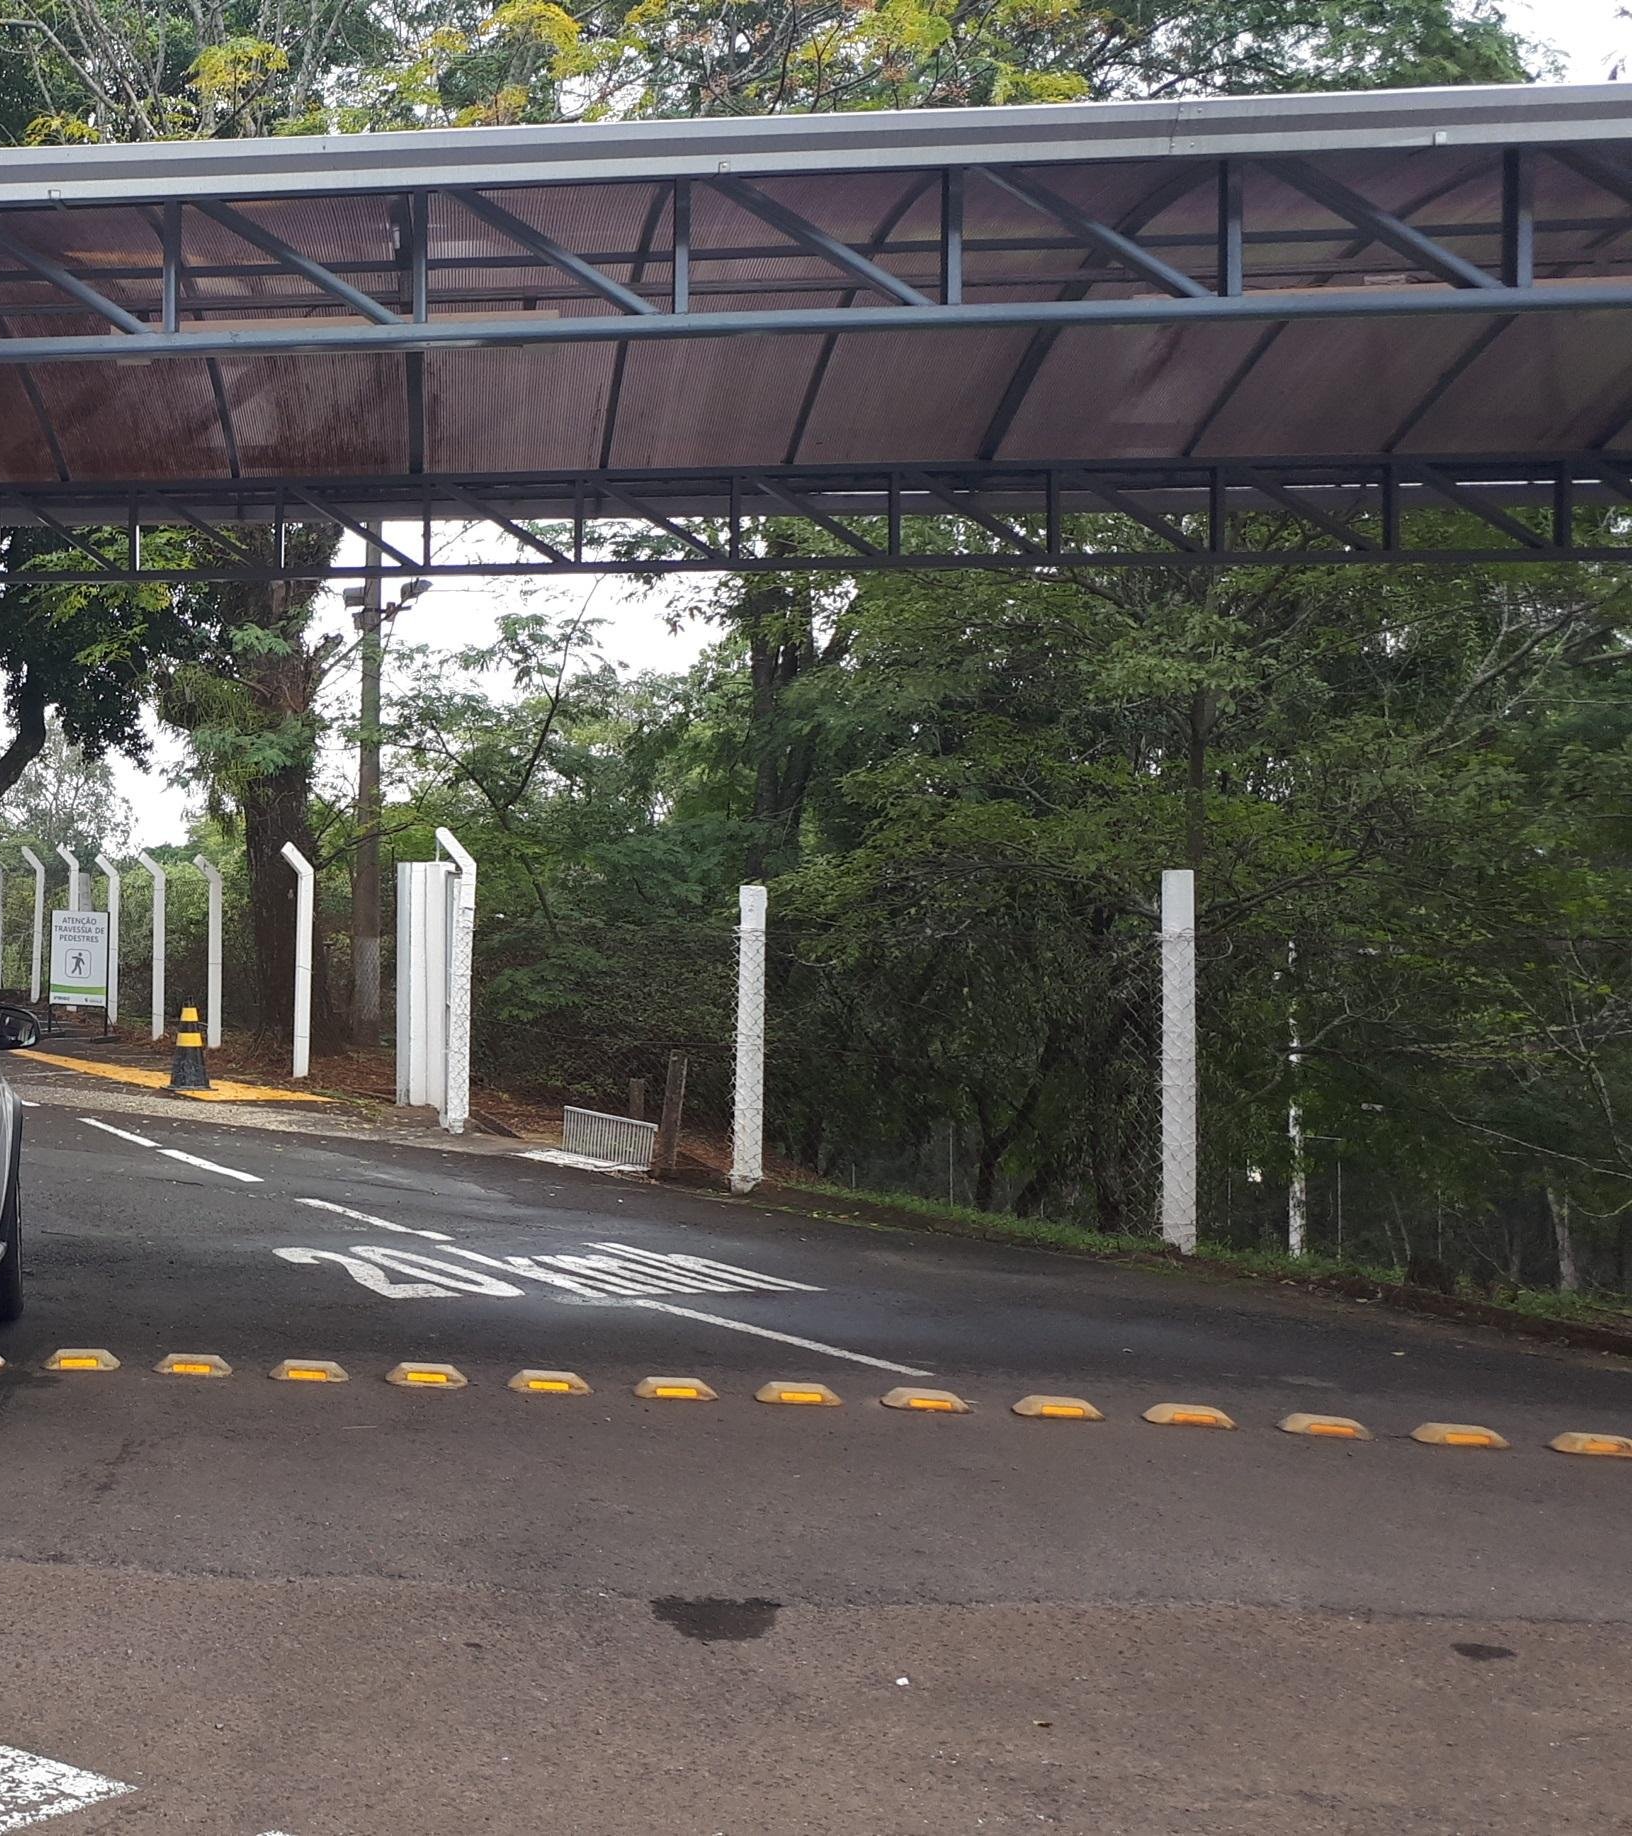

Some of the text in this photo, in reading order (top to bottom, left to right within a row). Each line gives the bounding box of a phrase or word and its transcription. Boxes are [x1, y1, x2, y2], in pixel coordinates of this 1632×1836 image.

[62, 916, 97, 926] ATENÇÃO
[54, 925, 105, 935] TRAVESSIA DE
[59, 934, 99, 943] PEDESTRES
